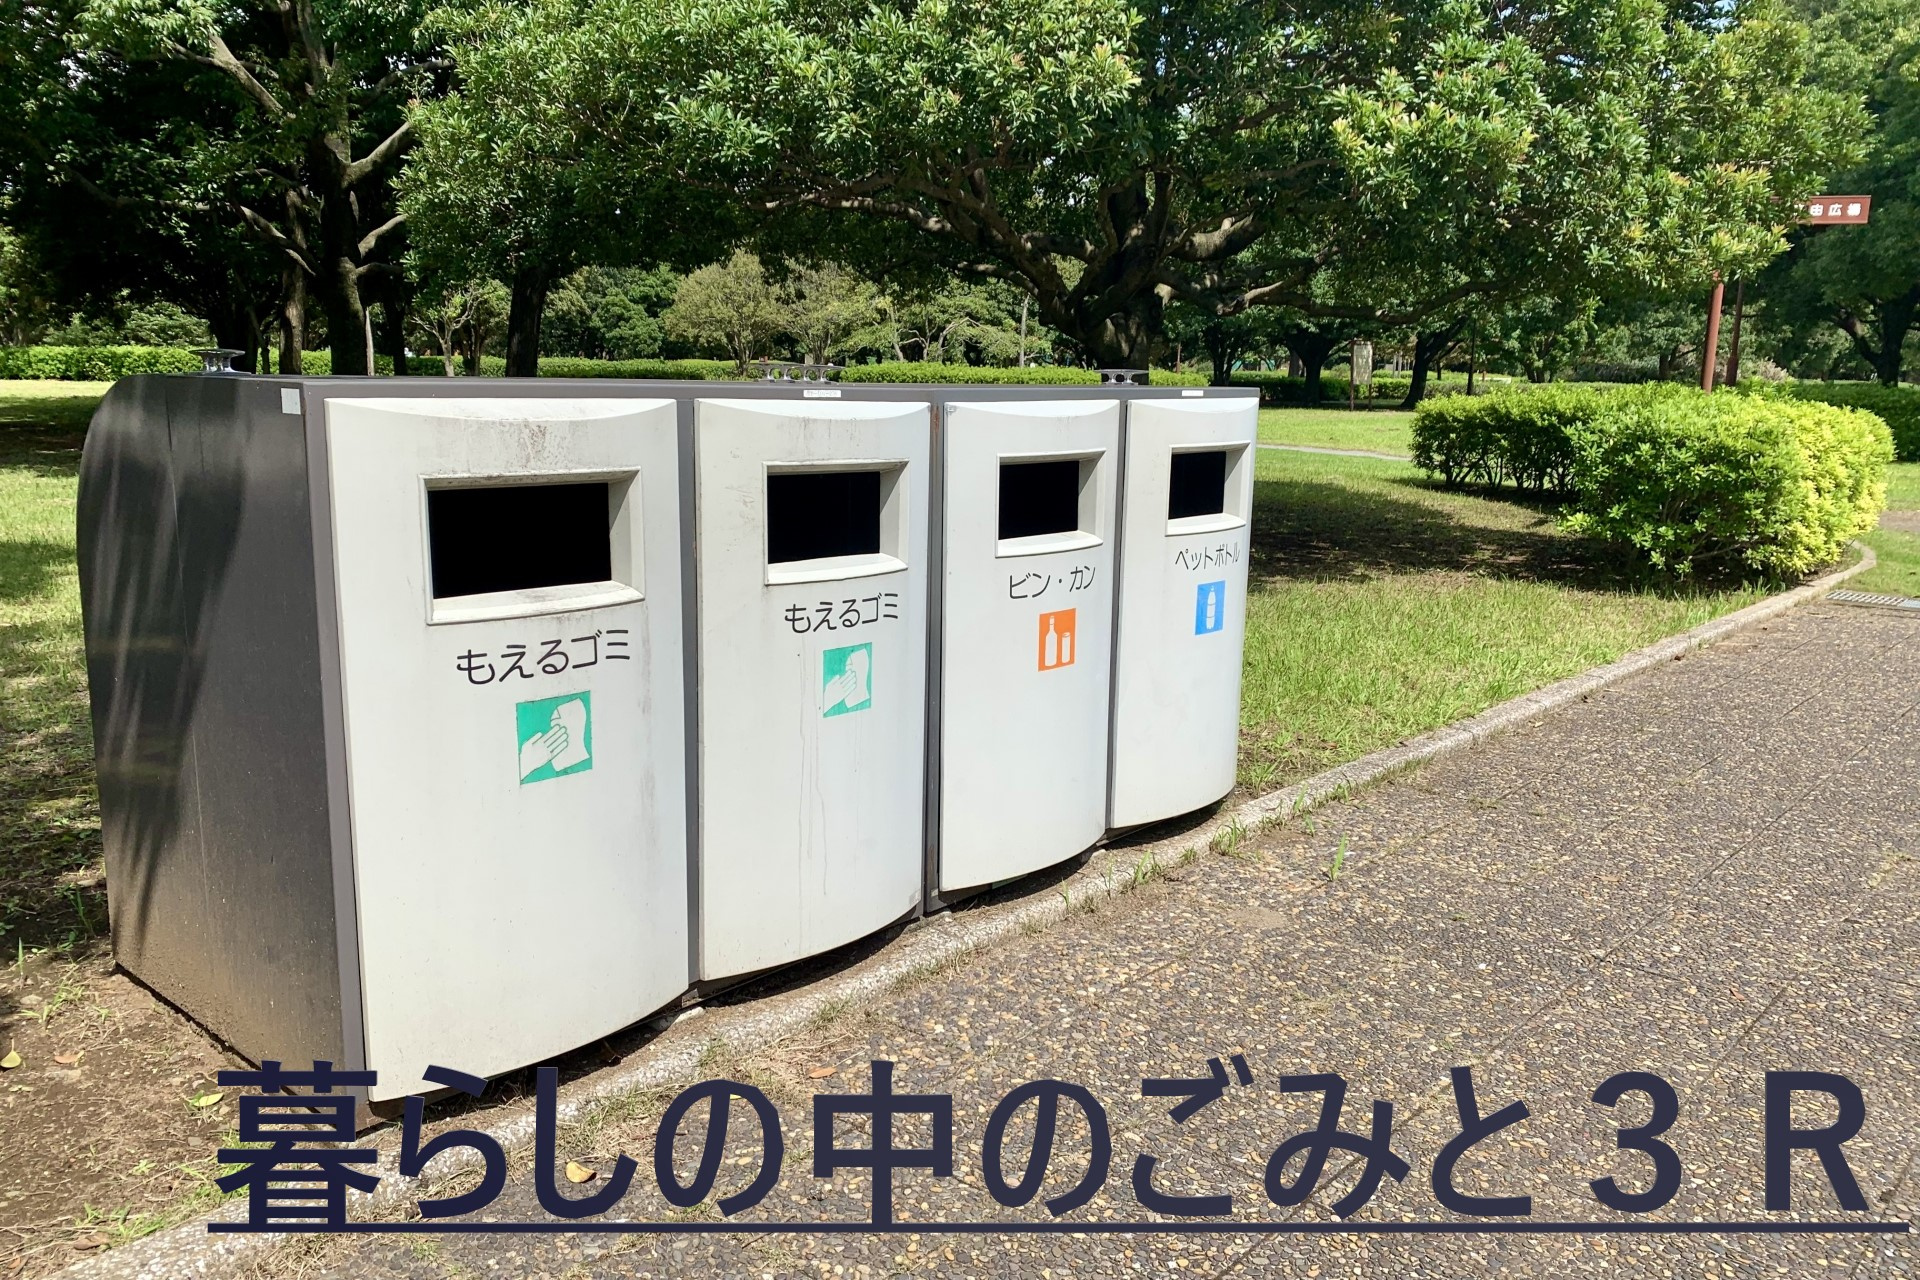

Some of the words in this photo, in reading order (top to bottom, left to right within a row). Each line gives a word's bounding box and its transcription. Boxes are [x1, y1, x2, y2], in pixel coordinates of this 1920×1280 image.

[1175, 542, 1240, 570] ペットボトル
[1010, 566, 1096, 599] ビン・カン
[784, 592, 899, 633] もえるゴミ
[456, 629, 630, 685] もえるゴミ
